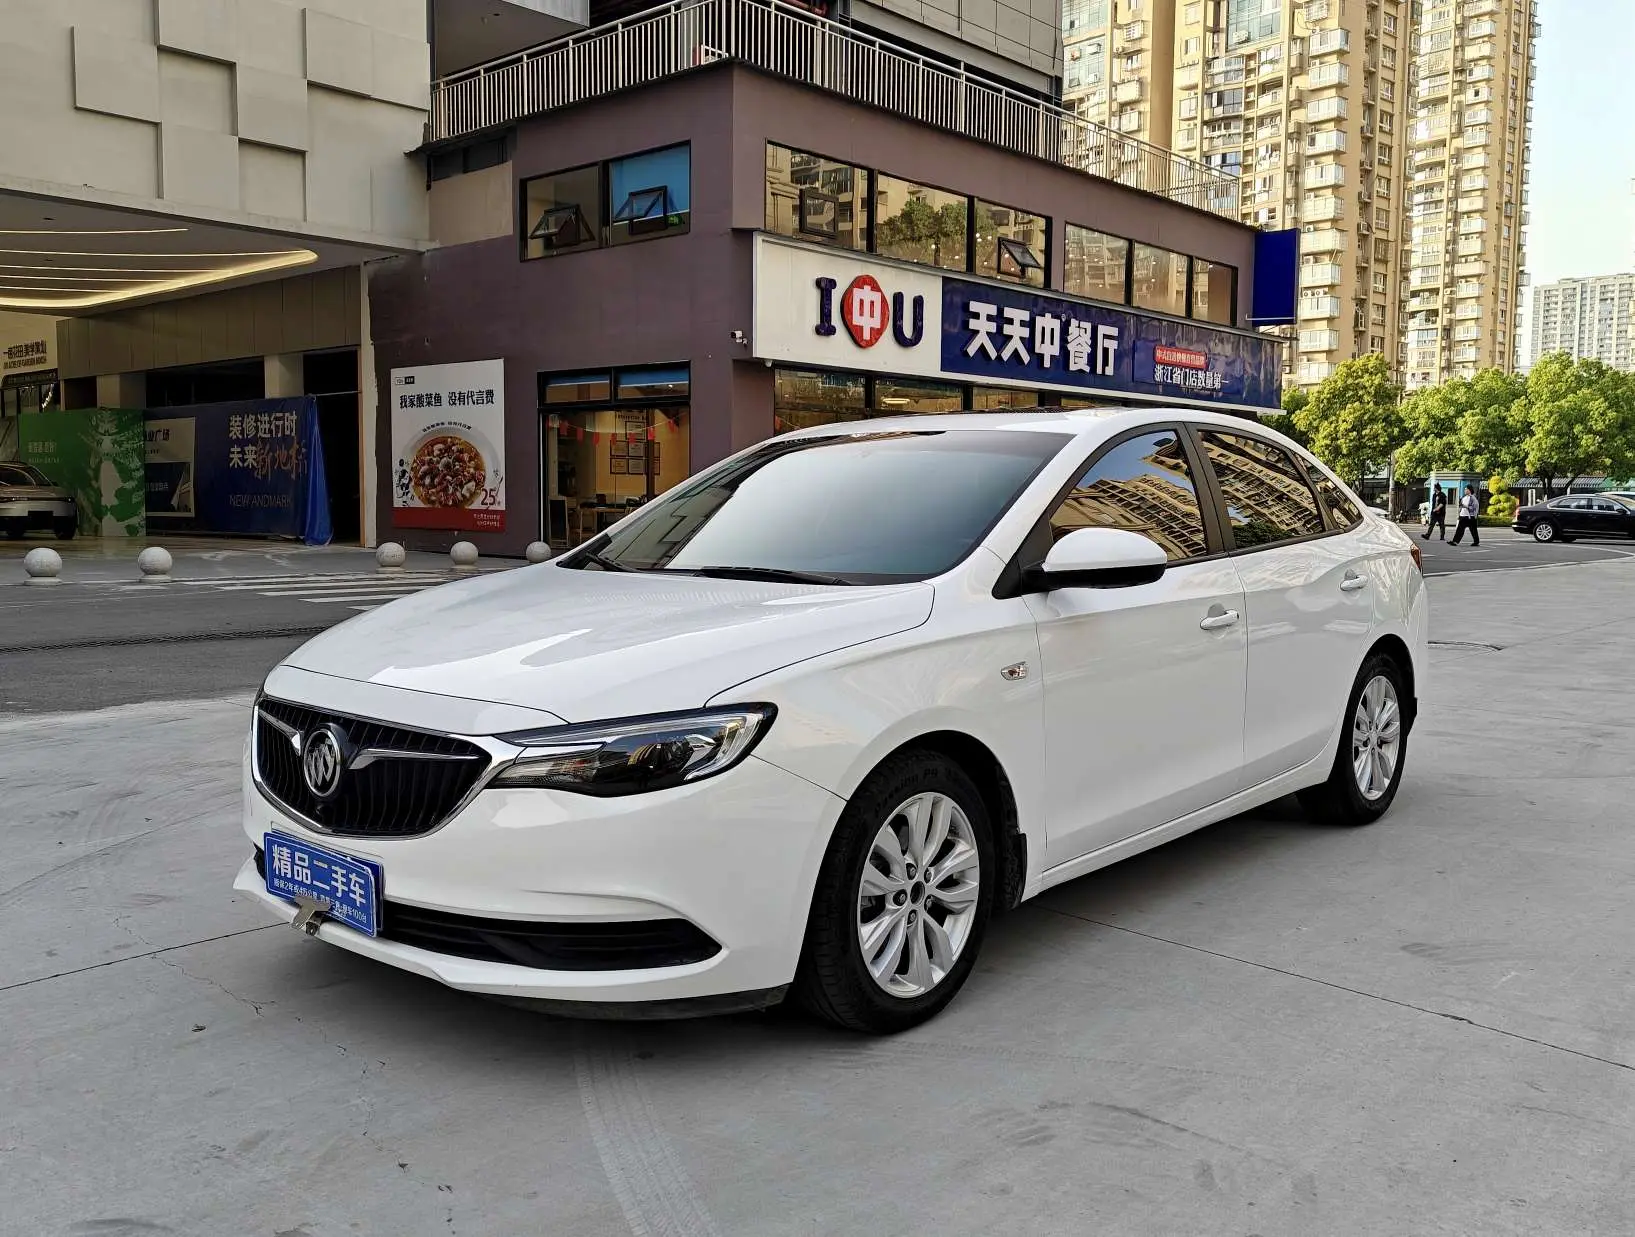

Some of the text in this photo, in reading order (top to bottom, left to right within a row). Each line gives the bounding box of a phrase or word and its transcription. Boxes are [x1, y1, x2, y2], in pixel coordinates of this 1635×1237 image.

[815, 276, 837, 336] I
[892, 291, 925, 348] U
[965, 300, 1119, 376] 天天中餐厅
[1154, 364, 1229, 390] 浙江省门店数量第一
[400, 389, 495, 409] 我家酸菜鱼 没有代言费
[229, 410, 297, 440] 装修进行时
[481, 488, 496, 506] 25
[271, 845, 367, 907] 精品二手车
